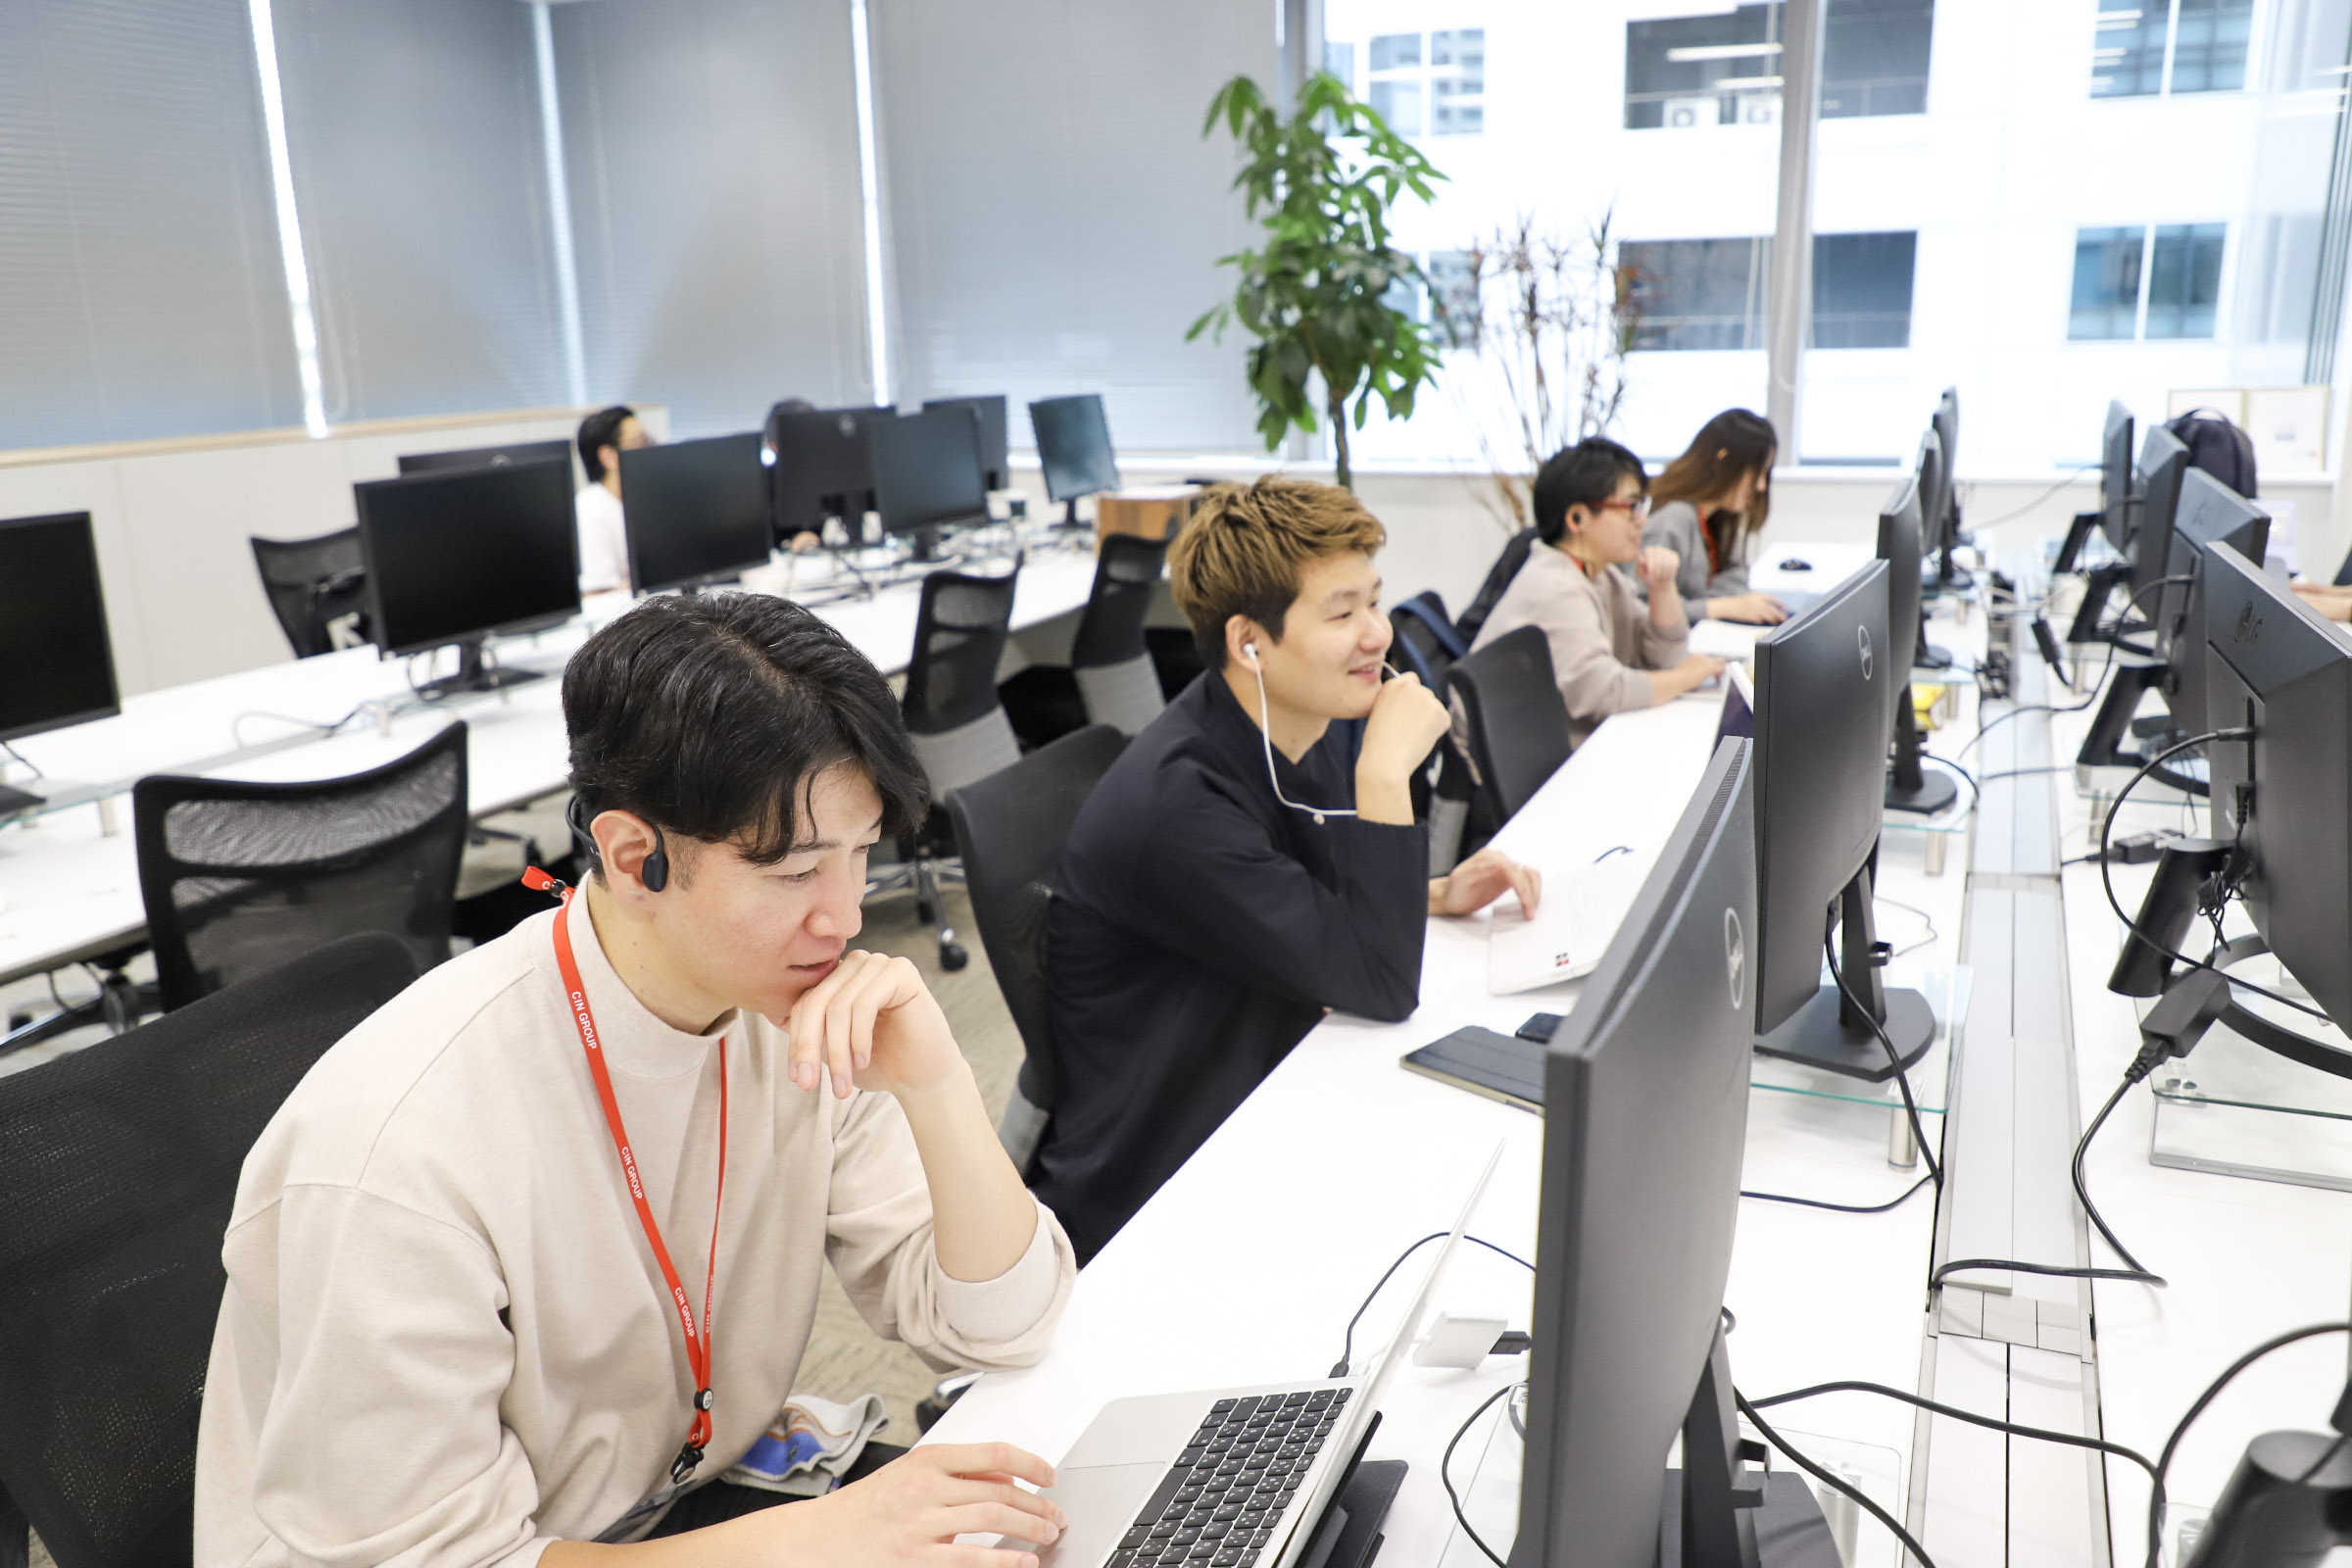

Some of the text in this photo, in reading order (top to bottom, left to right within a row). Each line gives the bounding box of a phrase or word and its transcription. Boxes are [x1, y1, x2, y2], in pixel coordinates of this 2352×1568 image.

[571, 991, 597, 1050] CIN GROUP
[621, 1147, 643, 1200] CIN GROUP
[675, 1287, 695, 1338] CIN GROUP
